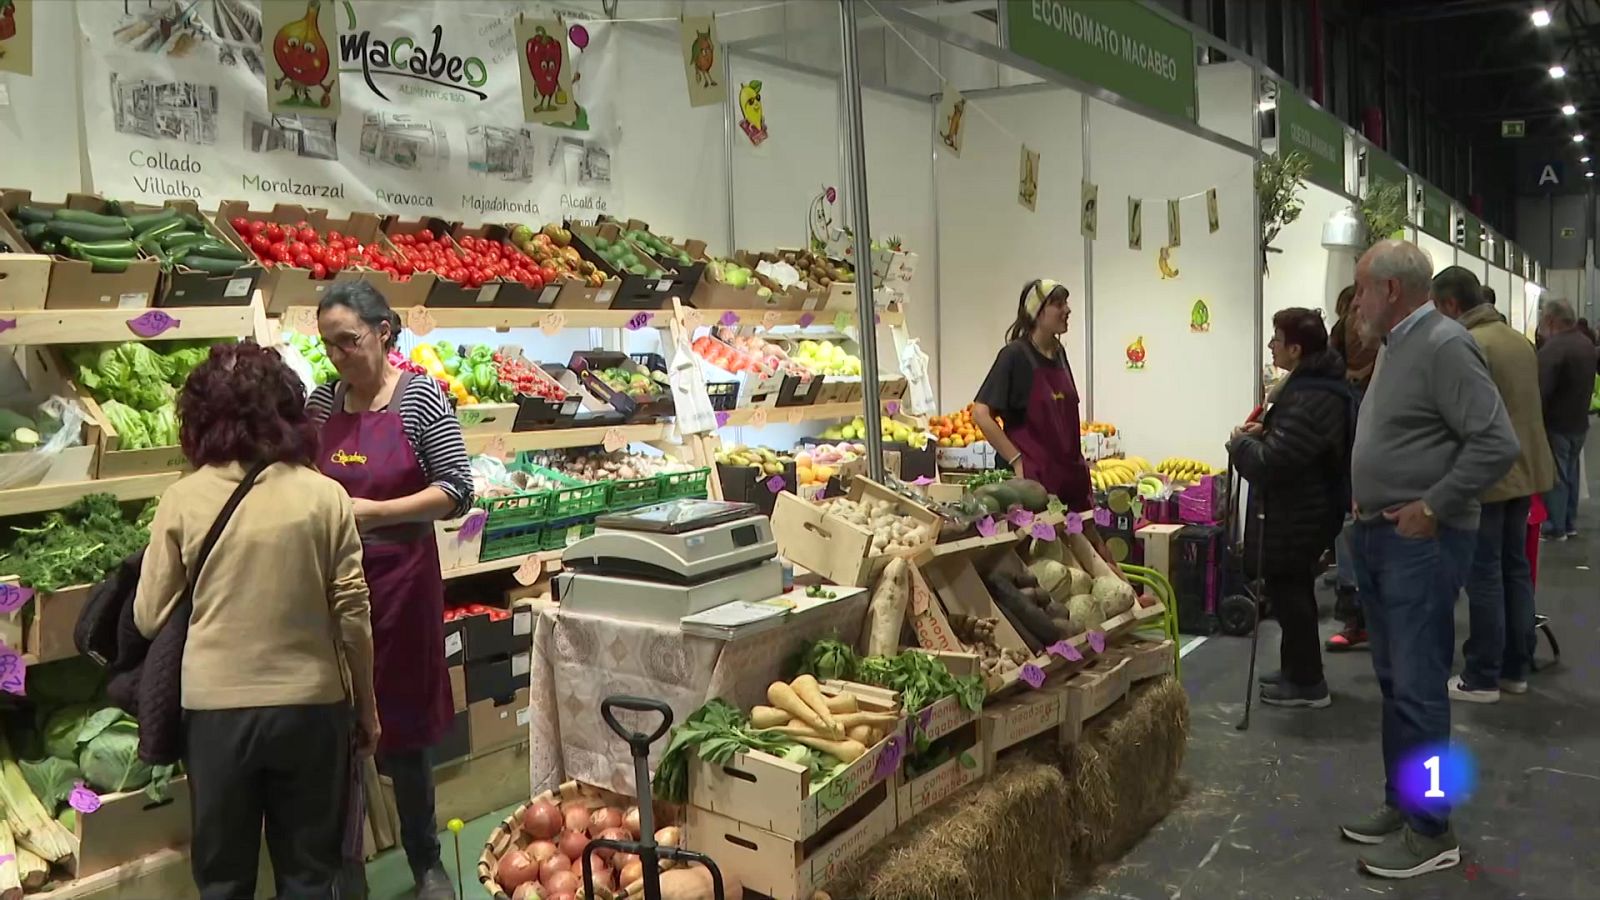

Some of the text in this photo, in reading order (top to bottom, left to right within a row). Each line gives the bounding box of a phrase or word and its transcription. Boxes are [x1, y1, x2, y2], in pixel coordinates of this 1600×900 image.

[1031, 0, 1177, 82] ECONOMATO MACABEO
[128, 149, 202, 173] Collado
[242, 174, 345, 199] Moralzarzal
[1538, 164, 1559, 186] A
[133, 175, 203, 199] Villalba
[375, 188, 434, 207] Aravaca
[461, 194, 540, 214] Majadahonda
[560, 192, 607, 211] Alcalá de
